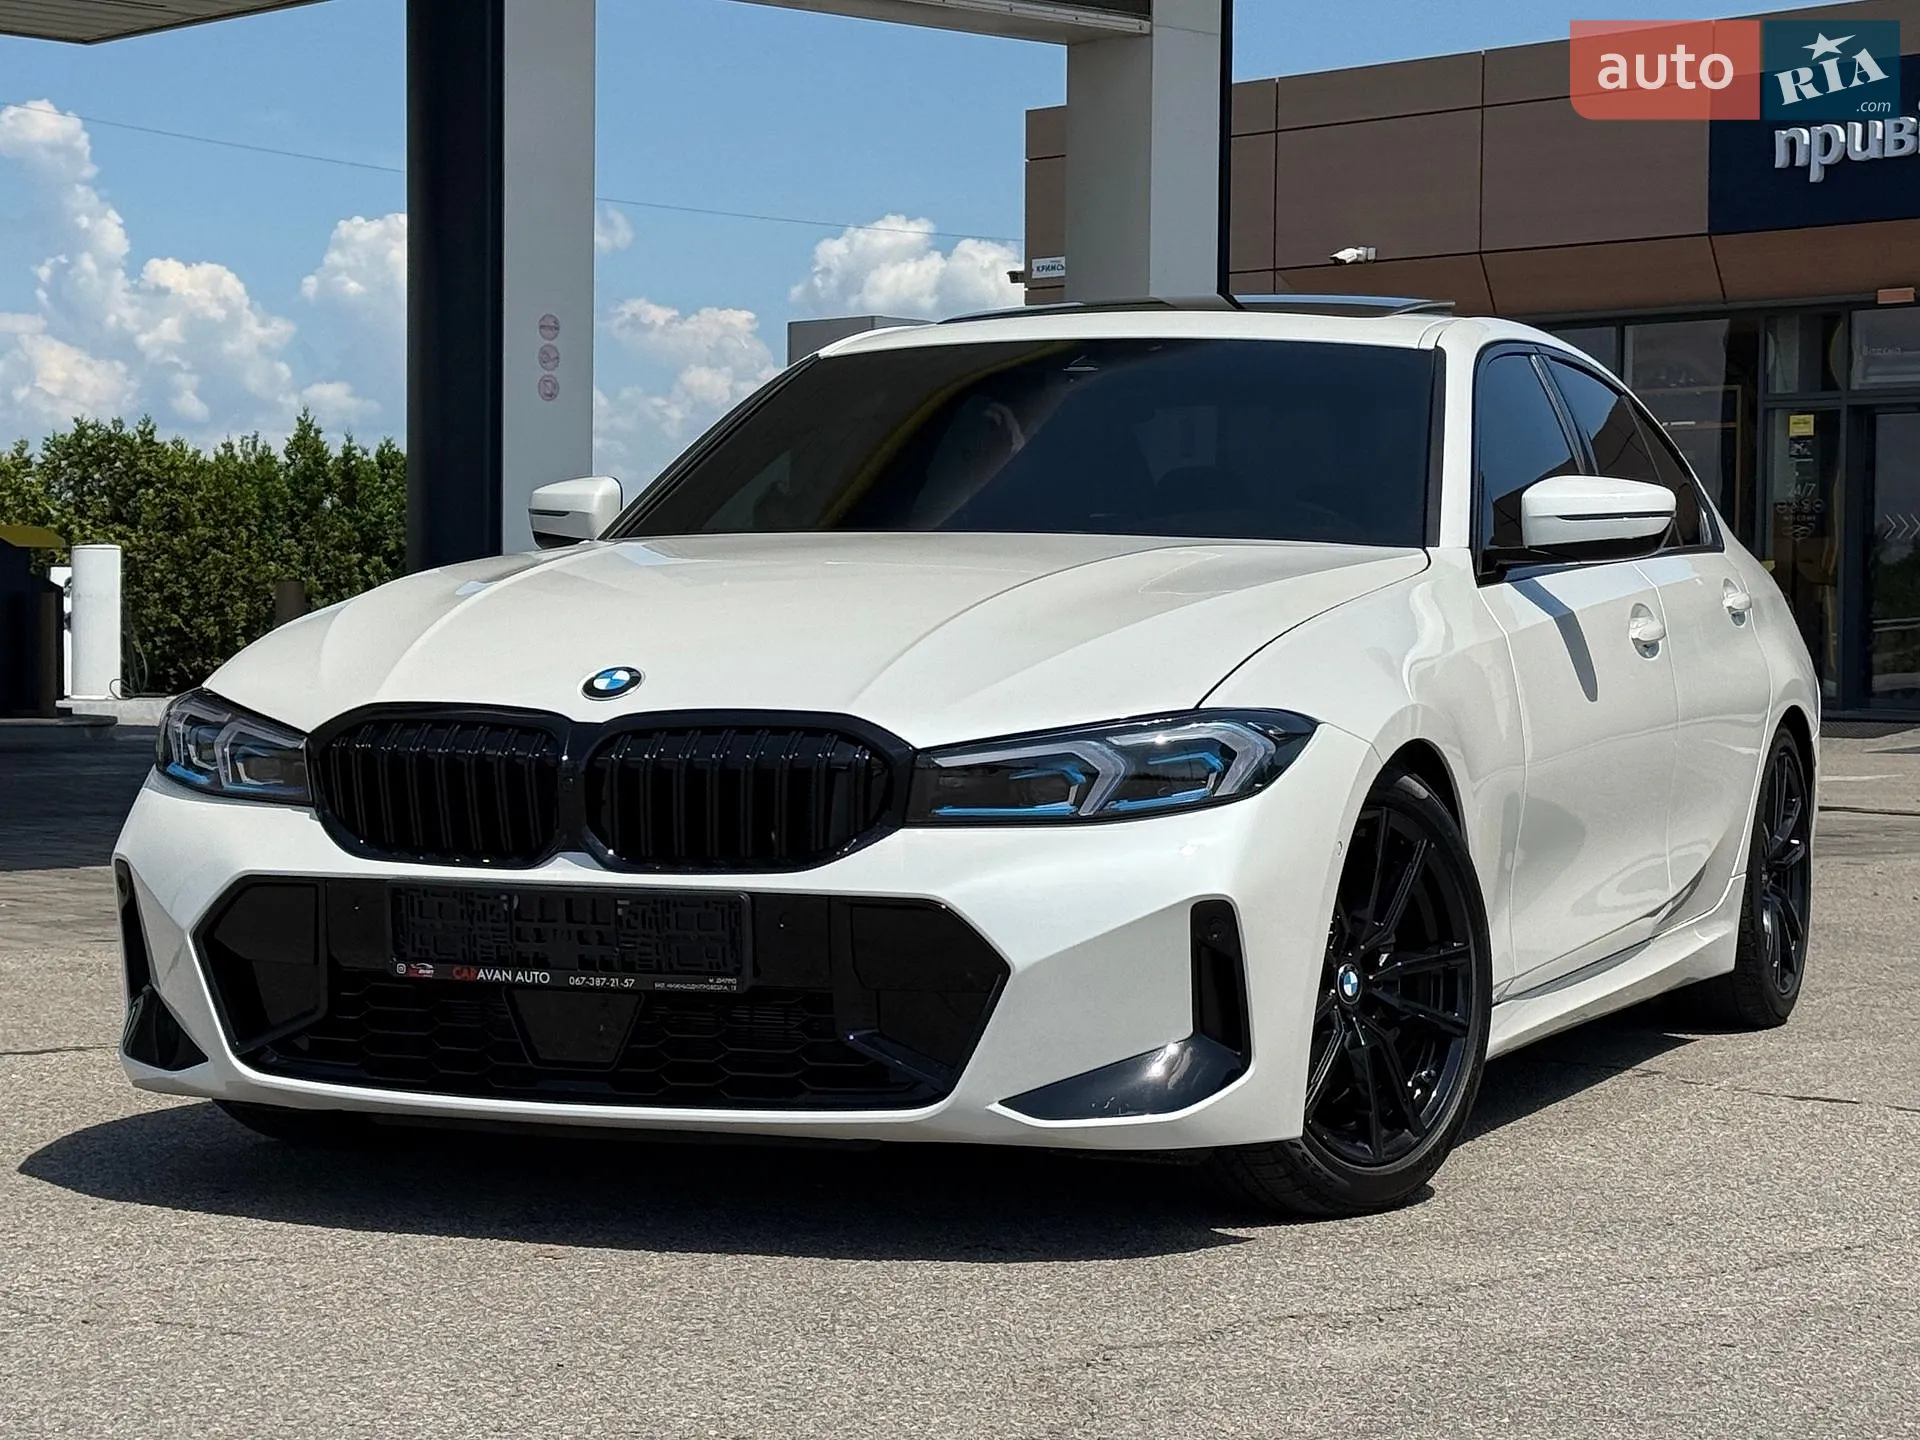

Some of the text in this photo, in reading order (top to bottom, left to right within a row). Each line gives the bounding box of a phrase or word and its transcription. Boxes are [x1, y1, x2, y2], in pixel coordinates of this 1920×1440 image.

[453, 966, 635, 988] CARAVAN AUTO 067-387-21-57
